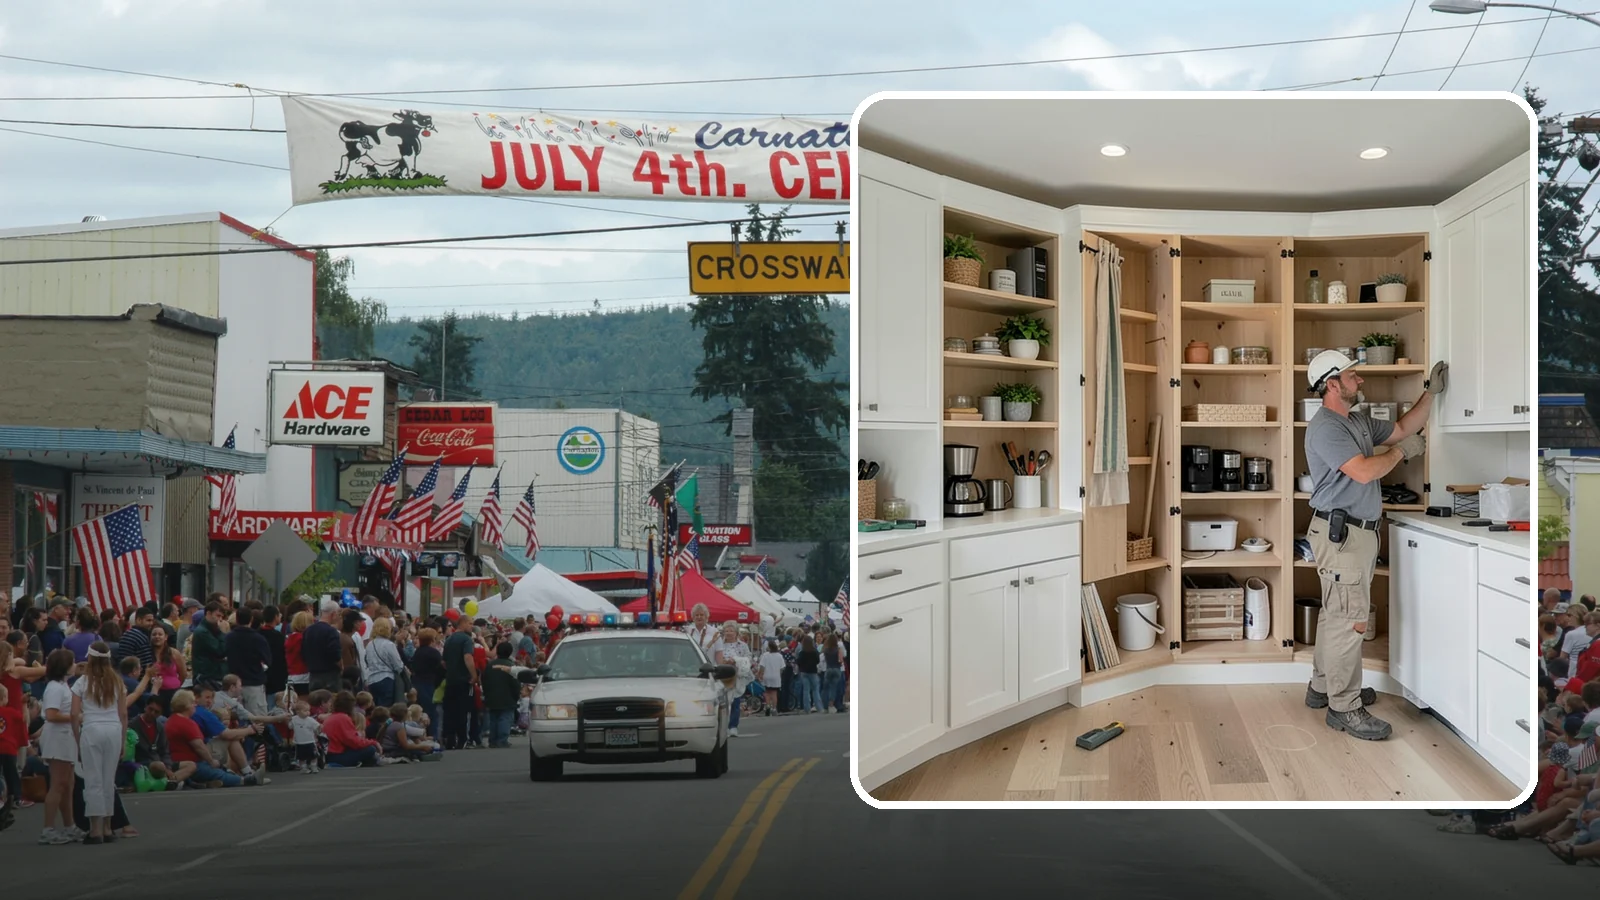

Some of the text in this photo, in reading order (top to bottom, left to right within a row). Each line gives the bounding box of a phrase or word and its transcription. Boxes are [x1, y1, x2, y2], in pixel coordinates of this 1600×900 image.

[481, 140, 604, 192] JULY
[631, 150, 745, 198] 4th.
[696, 254, 850, 281] CROSSWA
[282, 379, 373, 420] ACE
[404, 408, 453, 422] CEDAR
[283, 421, 370, 437] Hardware
[416, 427, 477, 447] Coca-Cola
[83, 484, 155, 495] St. Vincent de Paul
[688, 526, 741, 535] CRNATION
[699, 535, 730, 543] GLASS
